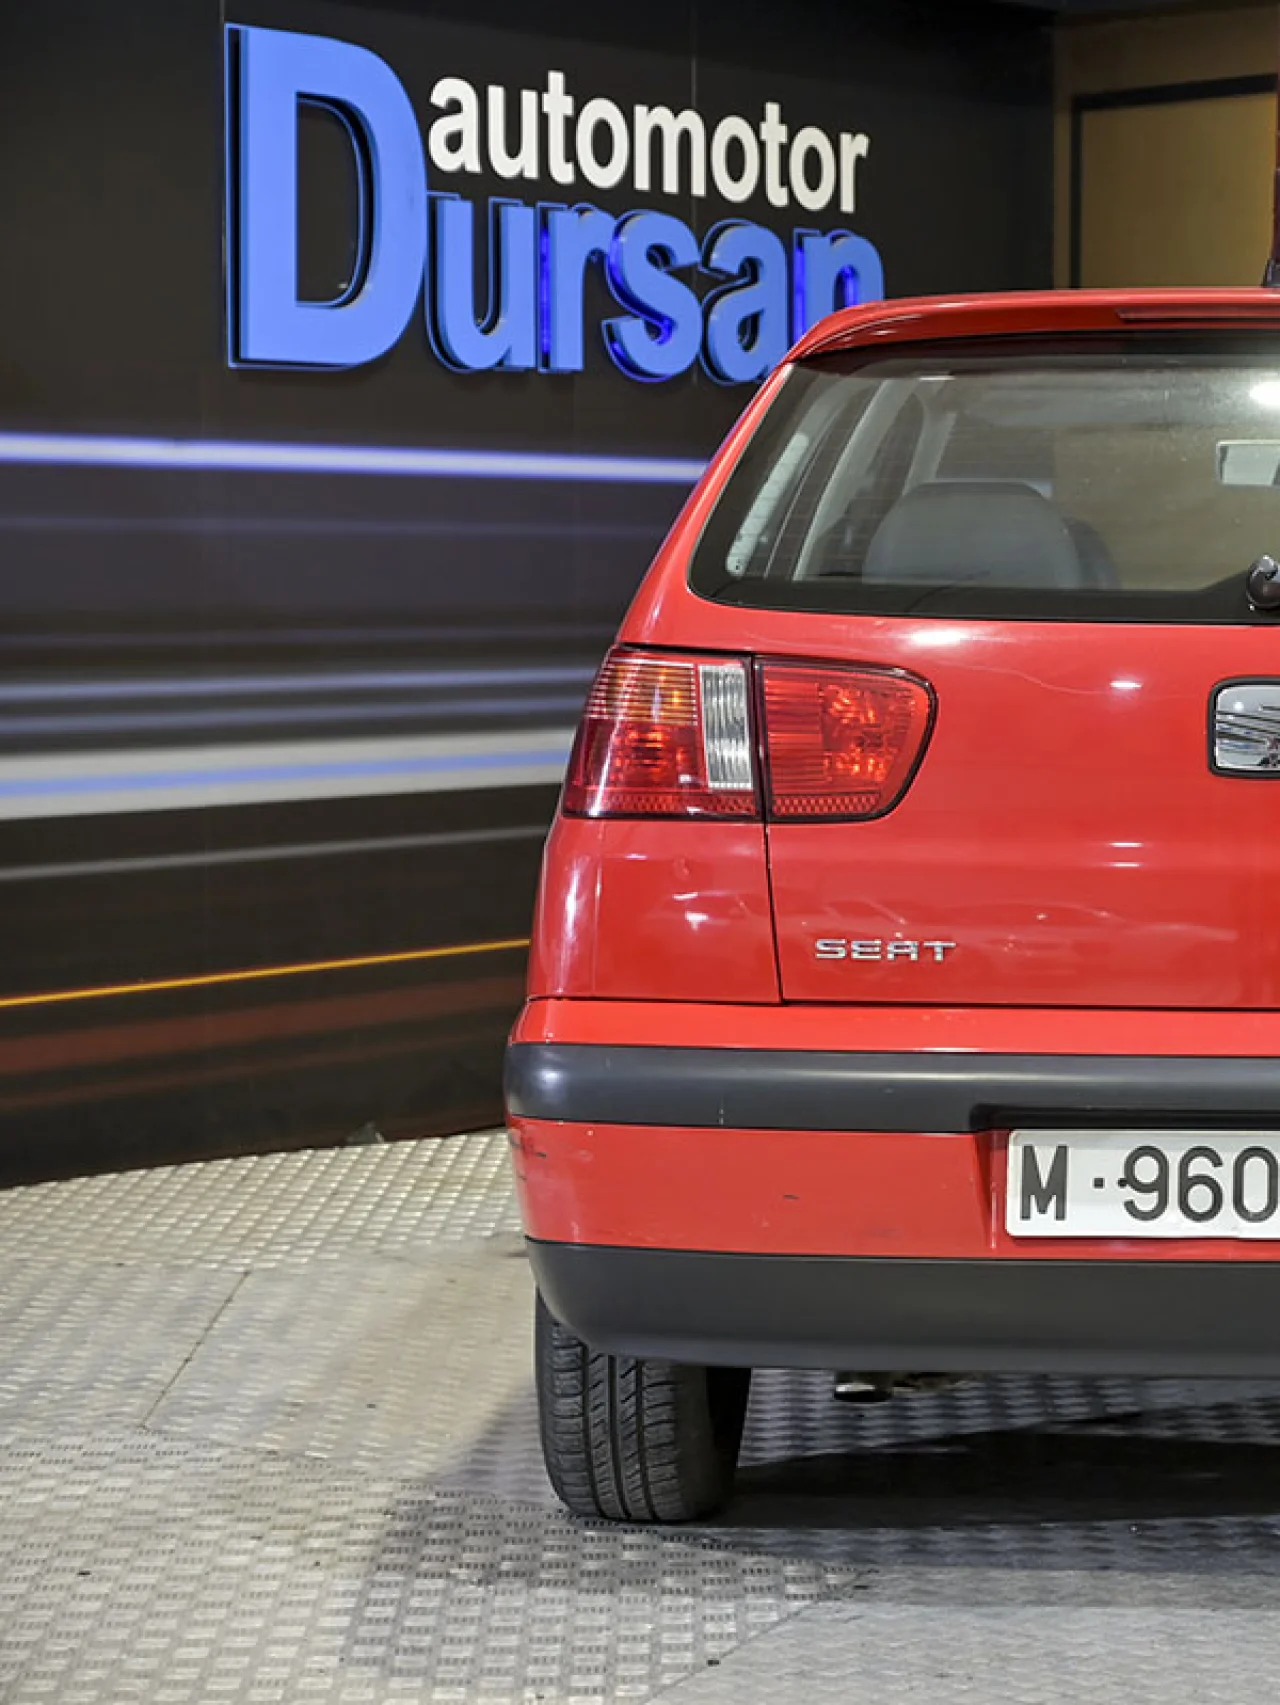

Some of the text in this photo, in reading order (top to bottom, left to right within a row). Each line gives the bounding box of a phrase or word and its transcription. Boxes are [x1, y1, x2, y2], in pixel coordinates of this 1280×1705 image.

[225, 22, 884, 387] Dursan
[428, 70, 869, 213] automotor
[815, 938, 957, 961] SEAT
